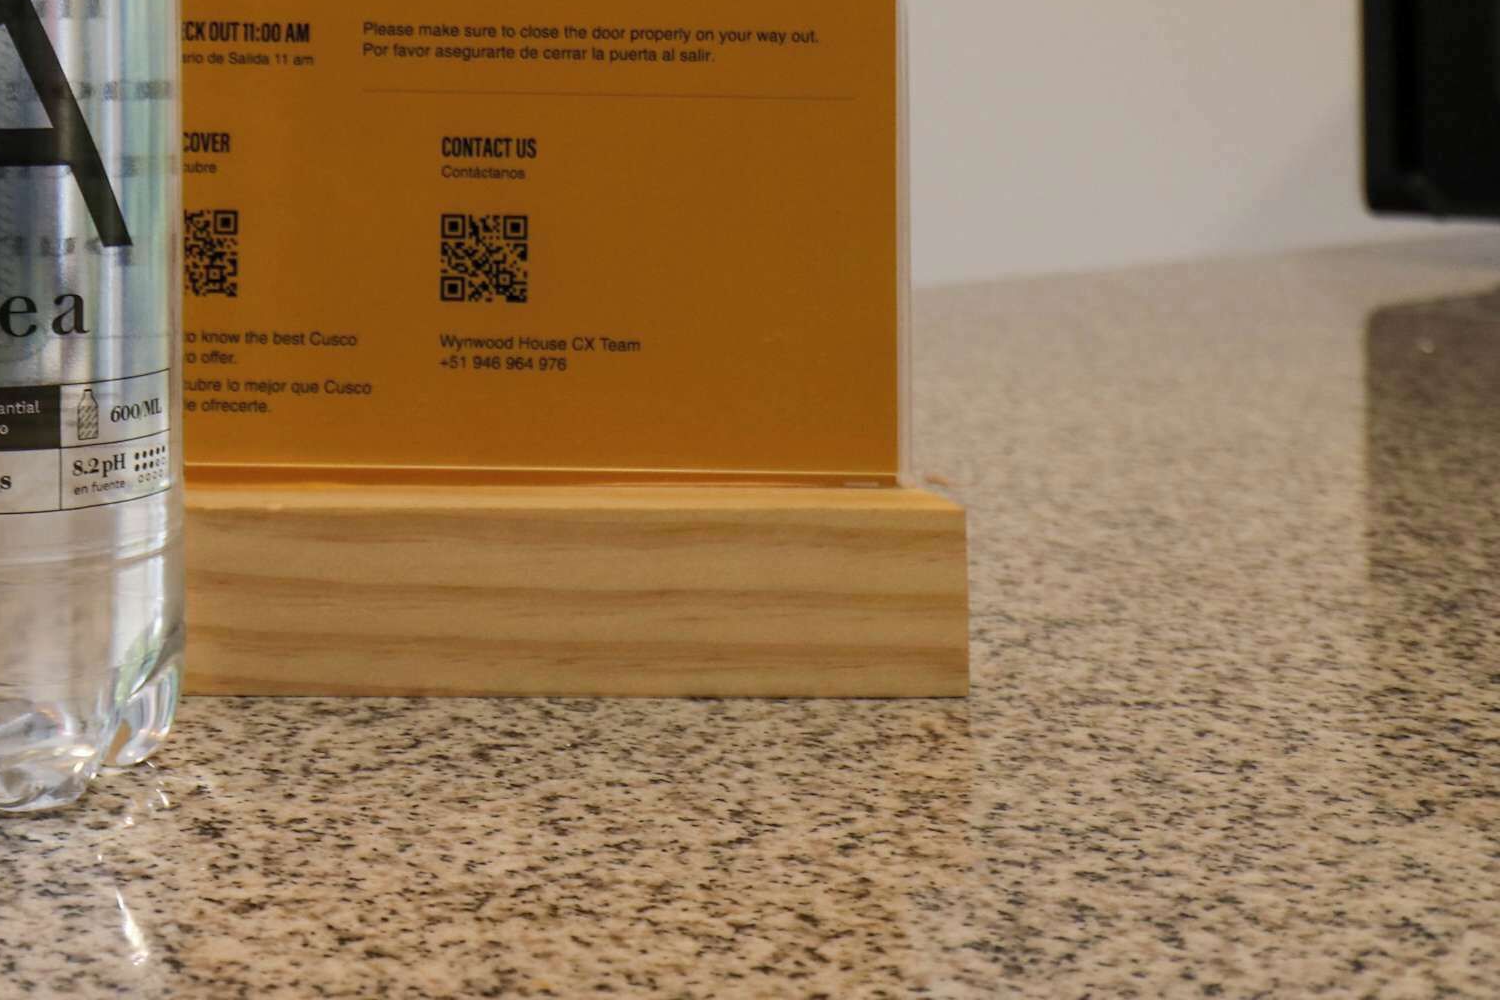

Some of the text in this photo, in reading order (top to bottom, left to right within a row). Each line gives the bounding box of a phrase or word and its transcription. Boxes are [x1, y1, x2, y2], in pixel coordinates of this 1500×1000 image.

[209, 21, 240, 42] OUT
[243, 22, 281, 42] 11:00
[285, 23, 310, 42] AM
[363, 21, 818, 45] Please make sure to close the door properly on your way out.
[207, 52, 224, 64] de
[228, 51, 270, 65] Salida
[275, 53, 288, 64] 11
[293, 56, 314, 66] am
[363, 42, 714, 63] Por favor asegurarte de cerrar la puerta al salir.
[442, 137, 537, 159] CONTACT US
[201, 330, 240, 344] know
[245, 331, 268, 344] the
[273, 332, 306, 345] best
[309, 331, 358, 346] Cusco
[440, 334, 640, 352] Wynwood House CX Team
[200, 350, 236, 364] offer.
[439, 354, 466, 369] +51
[473, 355, 501, 370] 946
[506, 356, 533, 370] 964
[227, 379, 240, 392] lo
[244, 380, 287, 395] mejor
[291, 382, 320, 396] que
[324, 379, 372, 395] Cusco
[201, 398, 269, 413] ofrecerte.
[74, 480, 125, 495] en fuente
